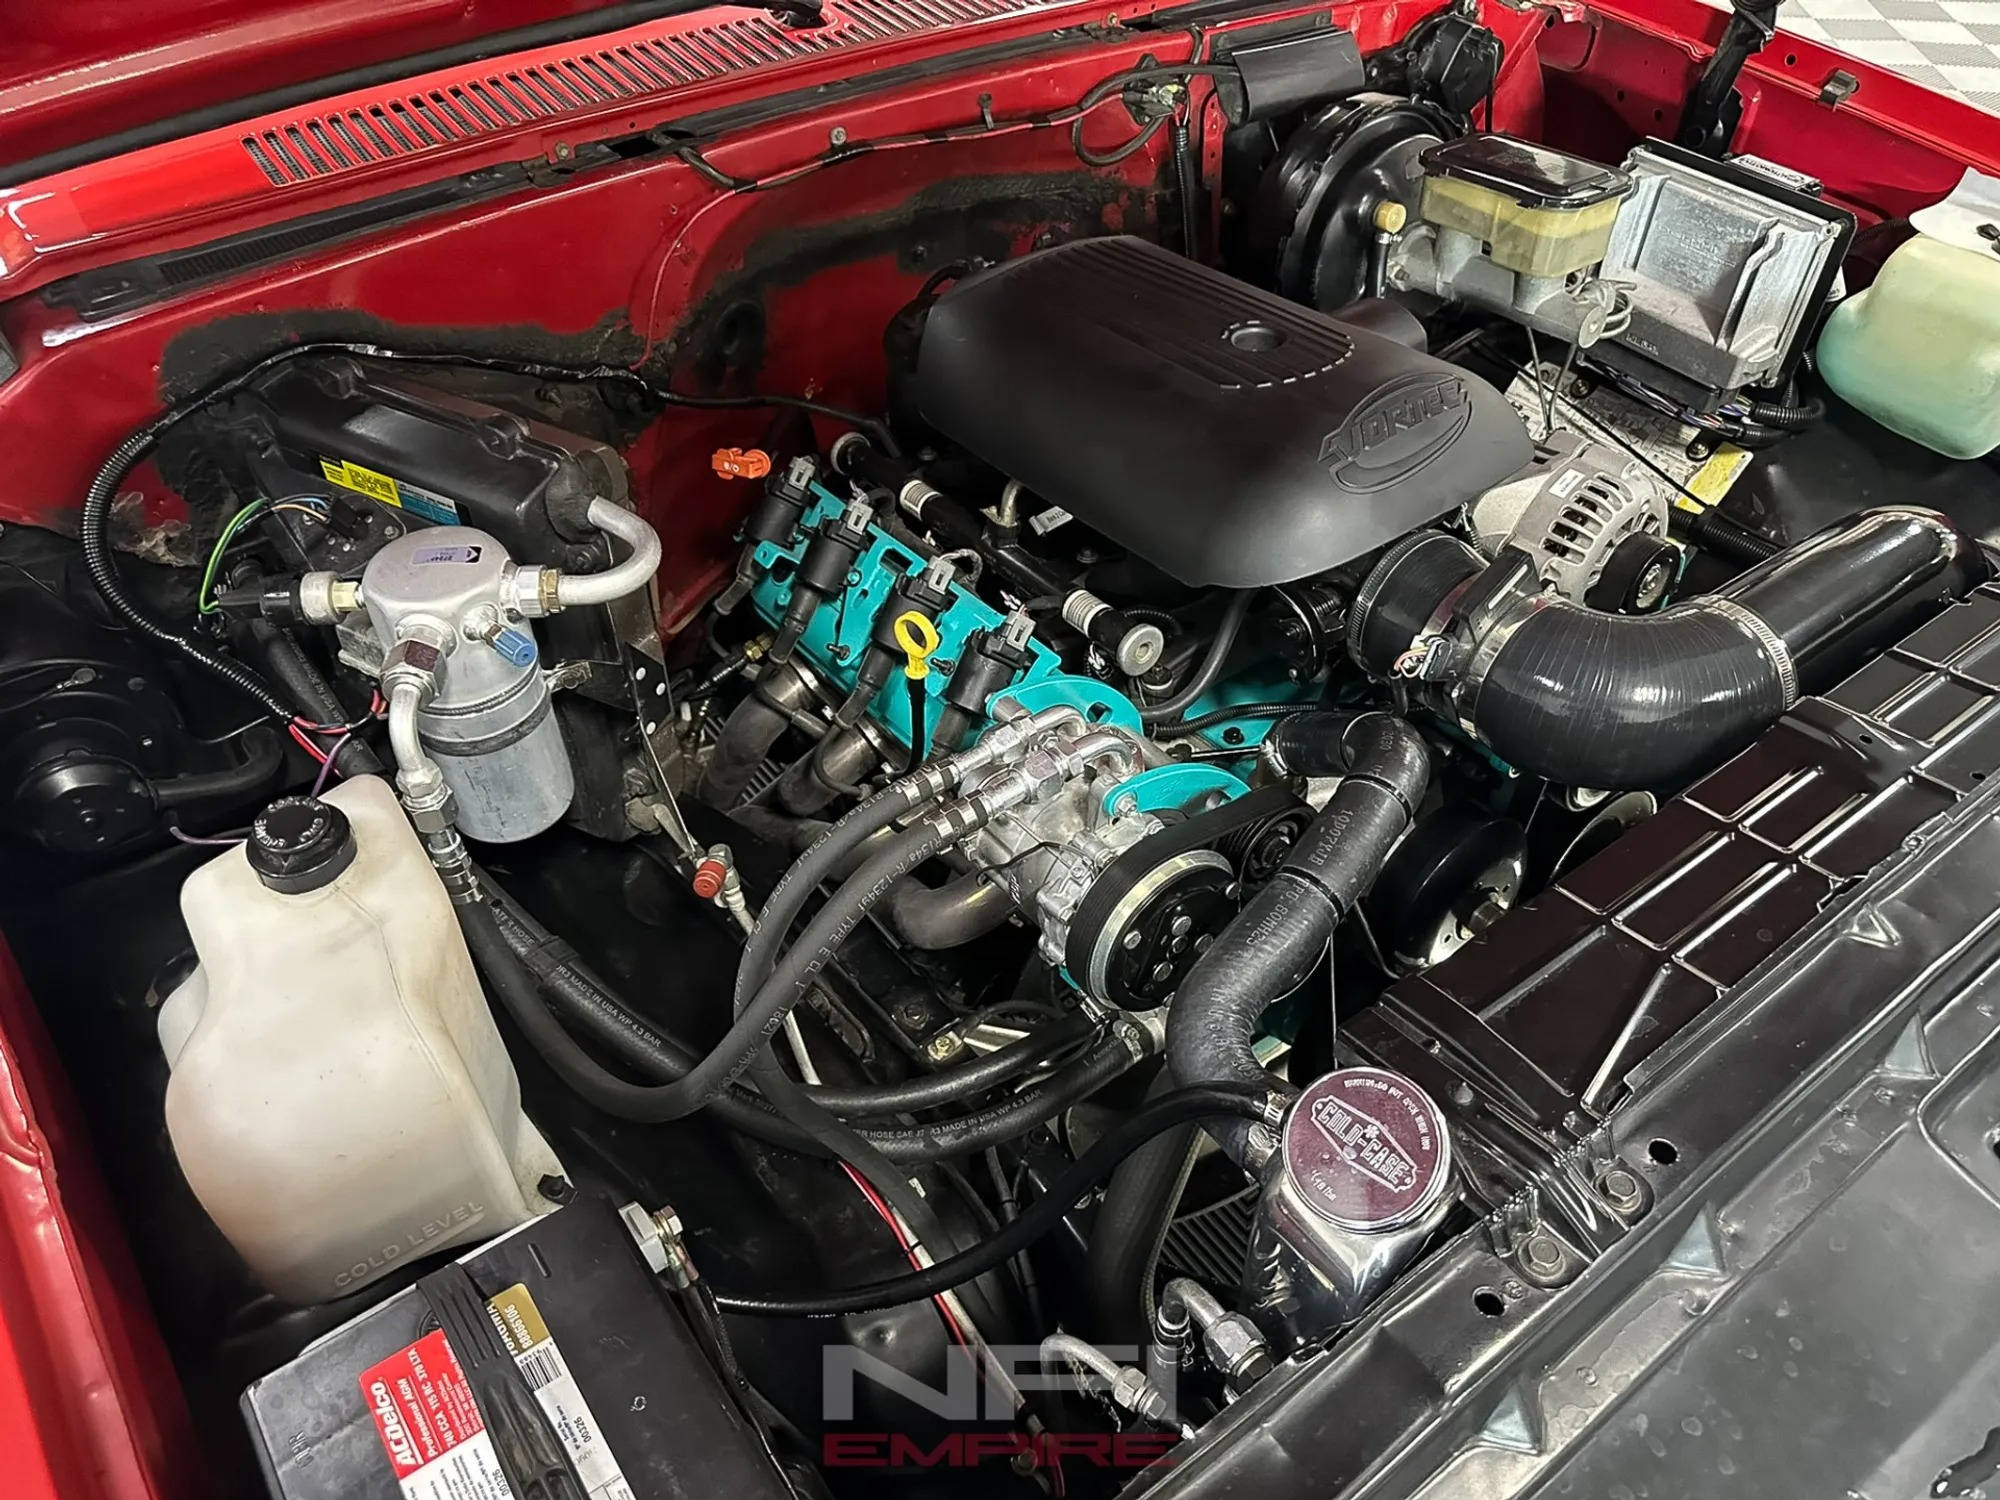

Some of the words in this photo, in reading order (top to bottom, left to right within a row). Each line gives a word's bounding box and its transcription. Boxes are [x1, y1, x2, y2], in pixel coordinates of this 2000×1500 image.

[510, 924, 535, 947] HOSE
[828, 913, 856, 945] TYPE
[818, 945, 831, 957] E
[569, 975, 593, 997] MADE
[590, 992, 602, 1003] IN
[600, 1000, 619, 1016] USA
[616, 1012, 633, 1026] WP
[642, 1030, 662, 1047] BAR
[869, 1130, 894, 1138] HOSE
[941, 1122, 967, 1134] MADE
[968, 1118, 978, 1127] IN
[979, 1111, 996, 1123] USA
[998, 1106, 1011, 1116] WP
[1026, 1089, 1042, 1104] BAR
[334, 1243, 401, 1287] COLD
[407, 1201, 484, 1246] LEVEL
[504, 1304, 533, 1348] 88866106
[412, 1363, 427, 1380] 370
[396, 1377, 414, 1401] AGM
[420, 1380, 434, 1395] RC
[426, 1393, 440, 1410] 115
[369, 1380, 416, 1463] ACDelco
[407, 1401, 438, 1456] Professional
[434, 1410, 450, 1431] CCA
[573, 1416, 591, 1442] 00326
[443, 1430, 457, 1447] 740
[491, 1468, 509, 1496] 00326
